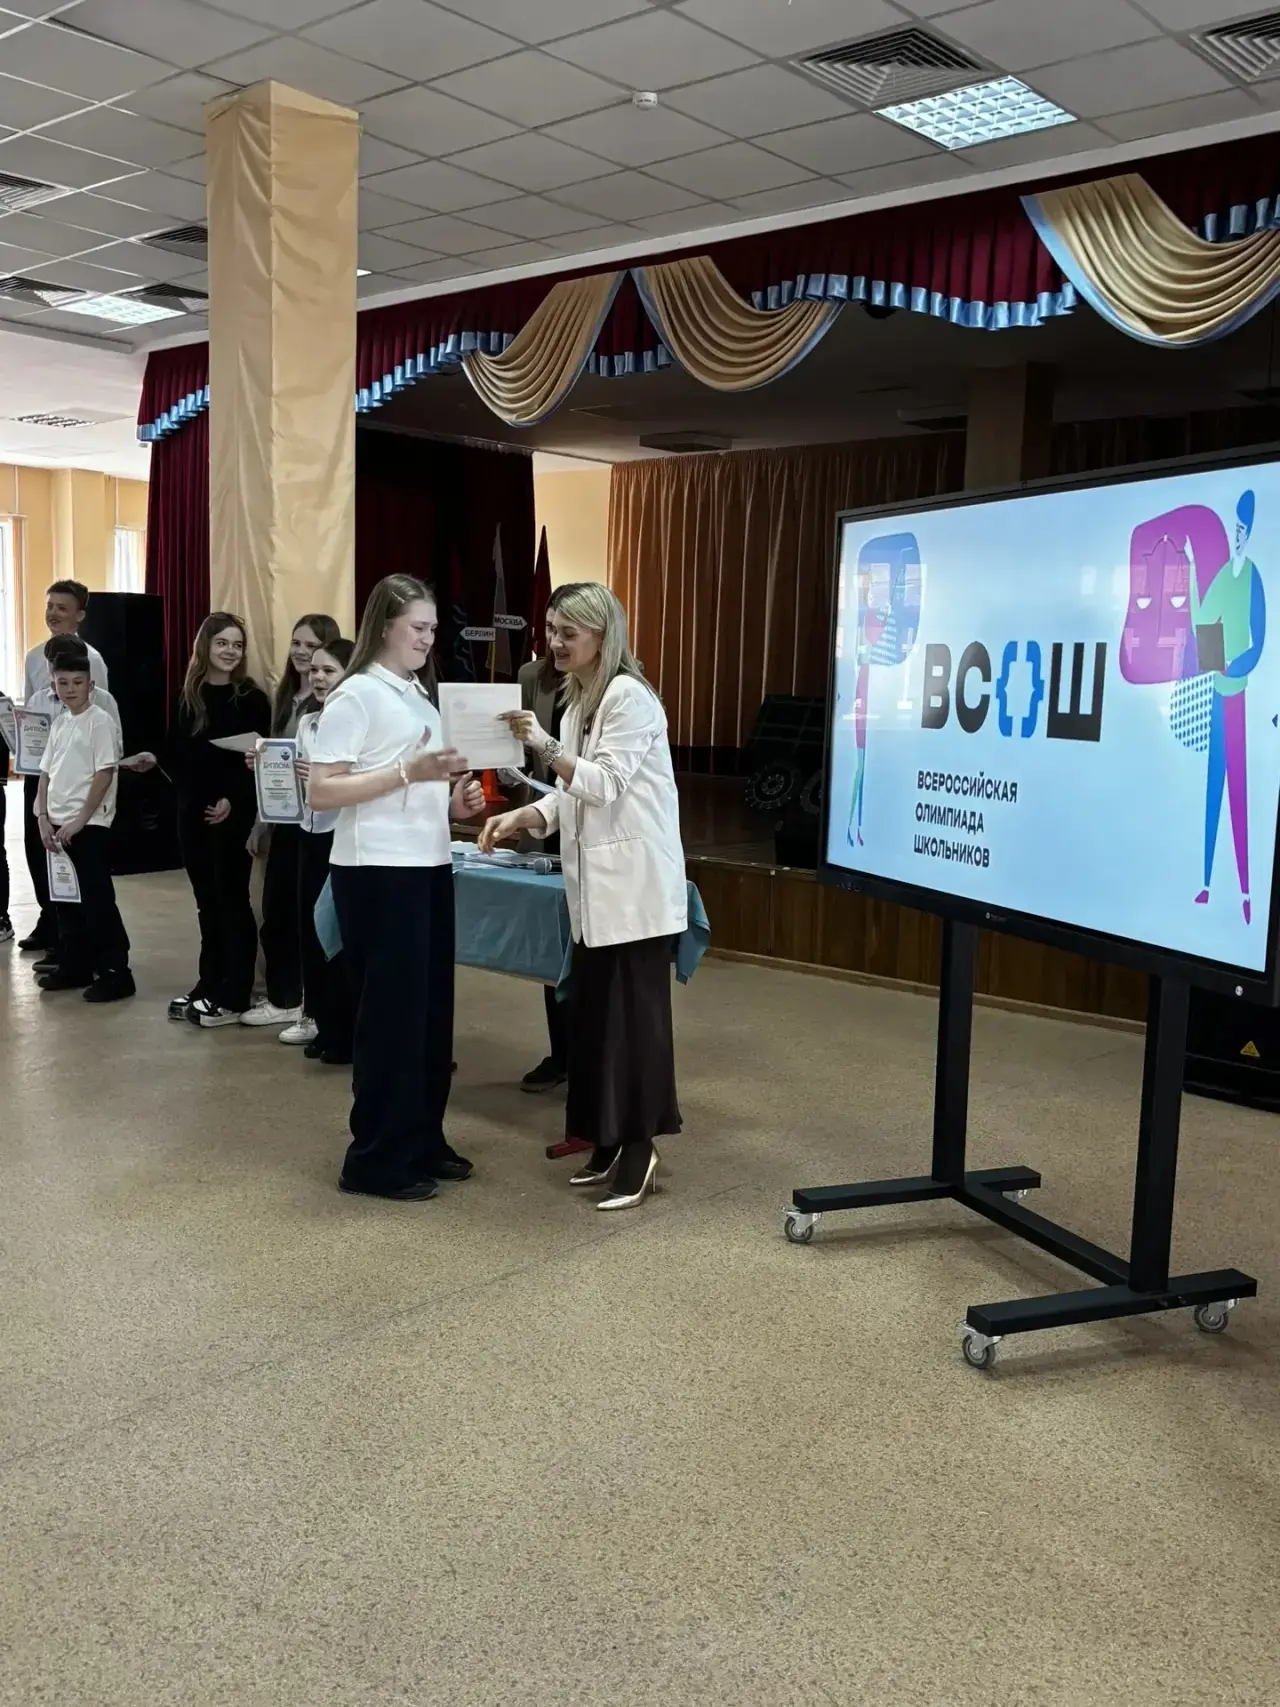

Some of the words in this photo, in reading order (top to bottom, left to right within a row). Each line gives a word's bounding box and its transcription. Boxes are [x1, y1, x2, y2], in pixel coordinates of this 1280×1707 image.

[464, 629, 494, 637] БЕРЛИН
[494, 616, 523, 626] МОСКВА
[917, 770, 1018, 803] ВСЕРОССИЙСКАЯ
[915, 802, 984, 835] ОЛИМПИАДА
[913, 834, 990, 868] ШКОЛЬНИКОВ
